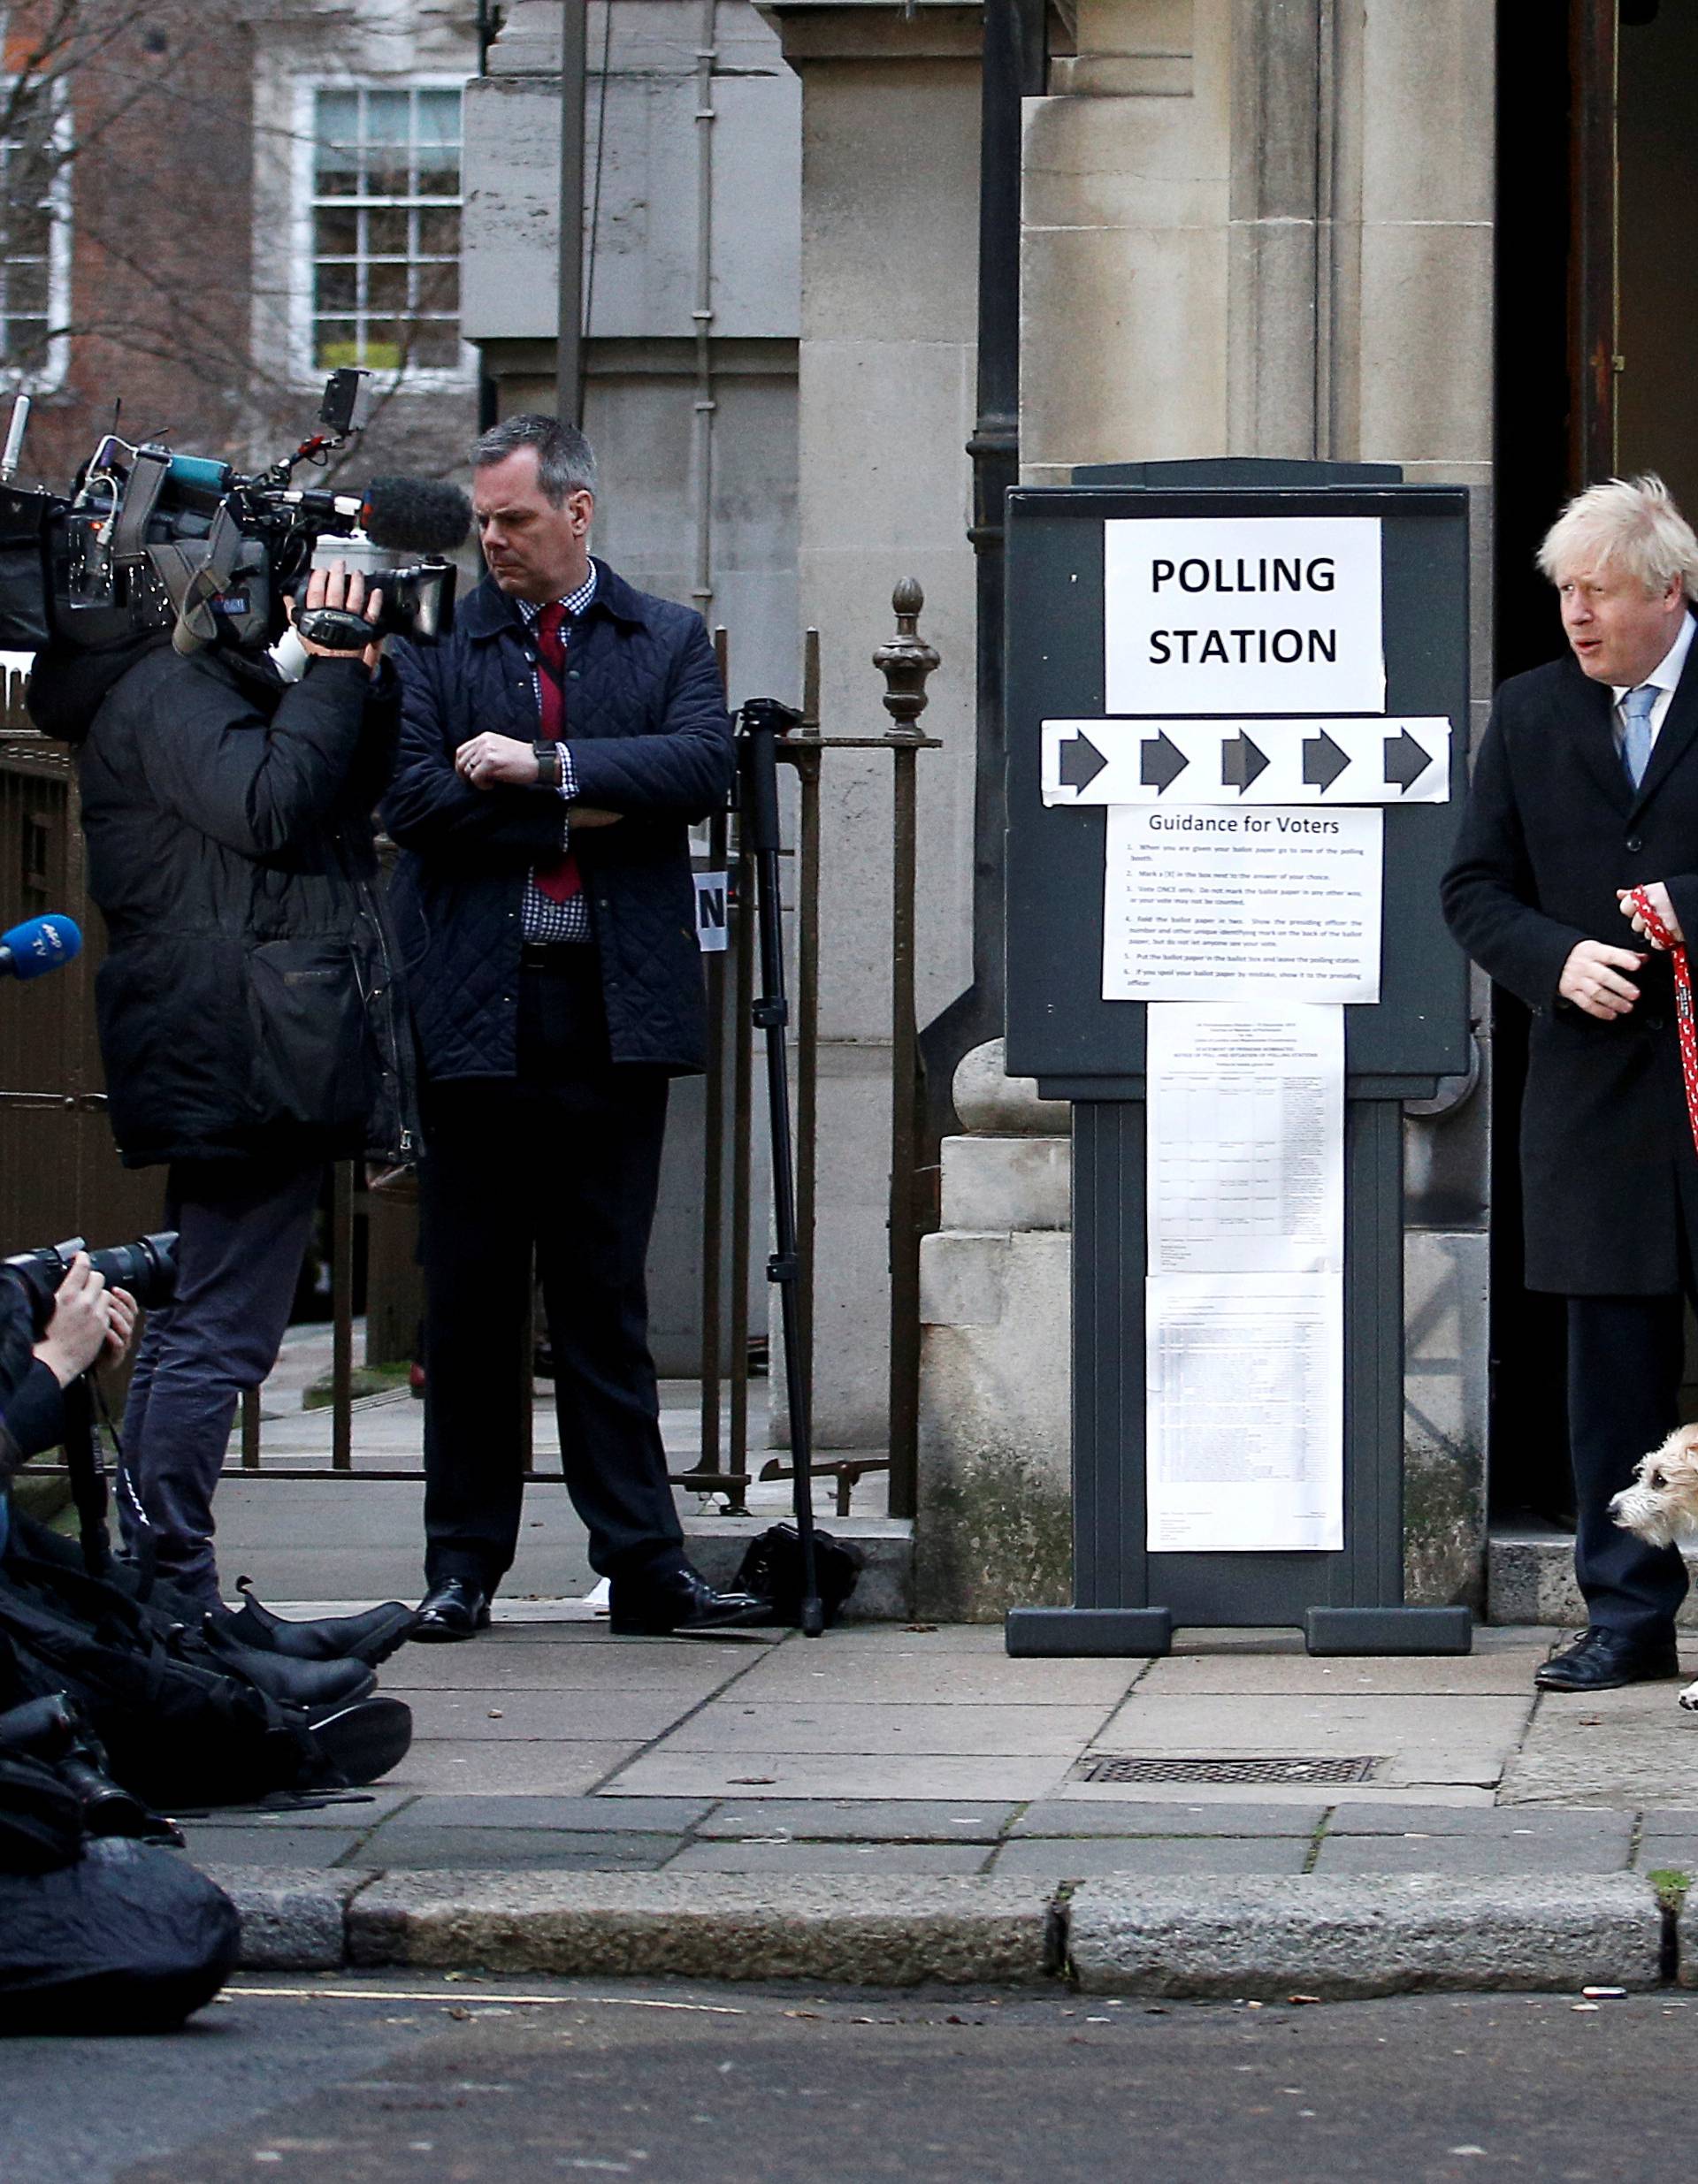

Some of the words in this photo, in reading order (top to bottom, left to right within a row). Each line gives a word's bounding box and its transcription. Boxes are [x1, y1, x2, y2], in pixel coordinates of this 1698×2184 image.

[1152, 558, 1335, 592] POLLING
[1149, 629, 1336, 664] STATION
[1149, 814, 1238, 831] Guidance
[1243, 815, 1271, 832] for
[1276, 817, 1339, 834] Voters
[699, 888, 725, 928] N
[33, 938, 48, 956] TV
